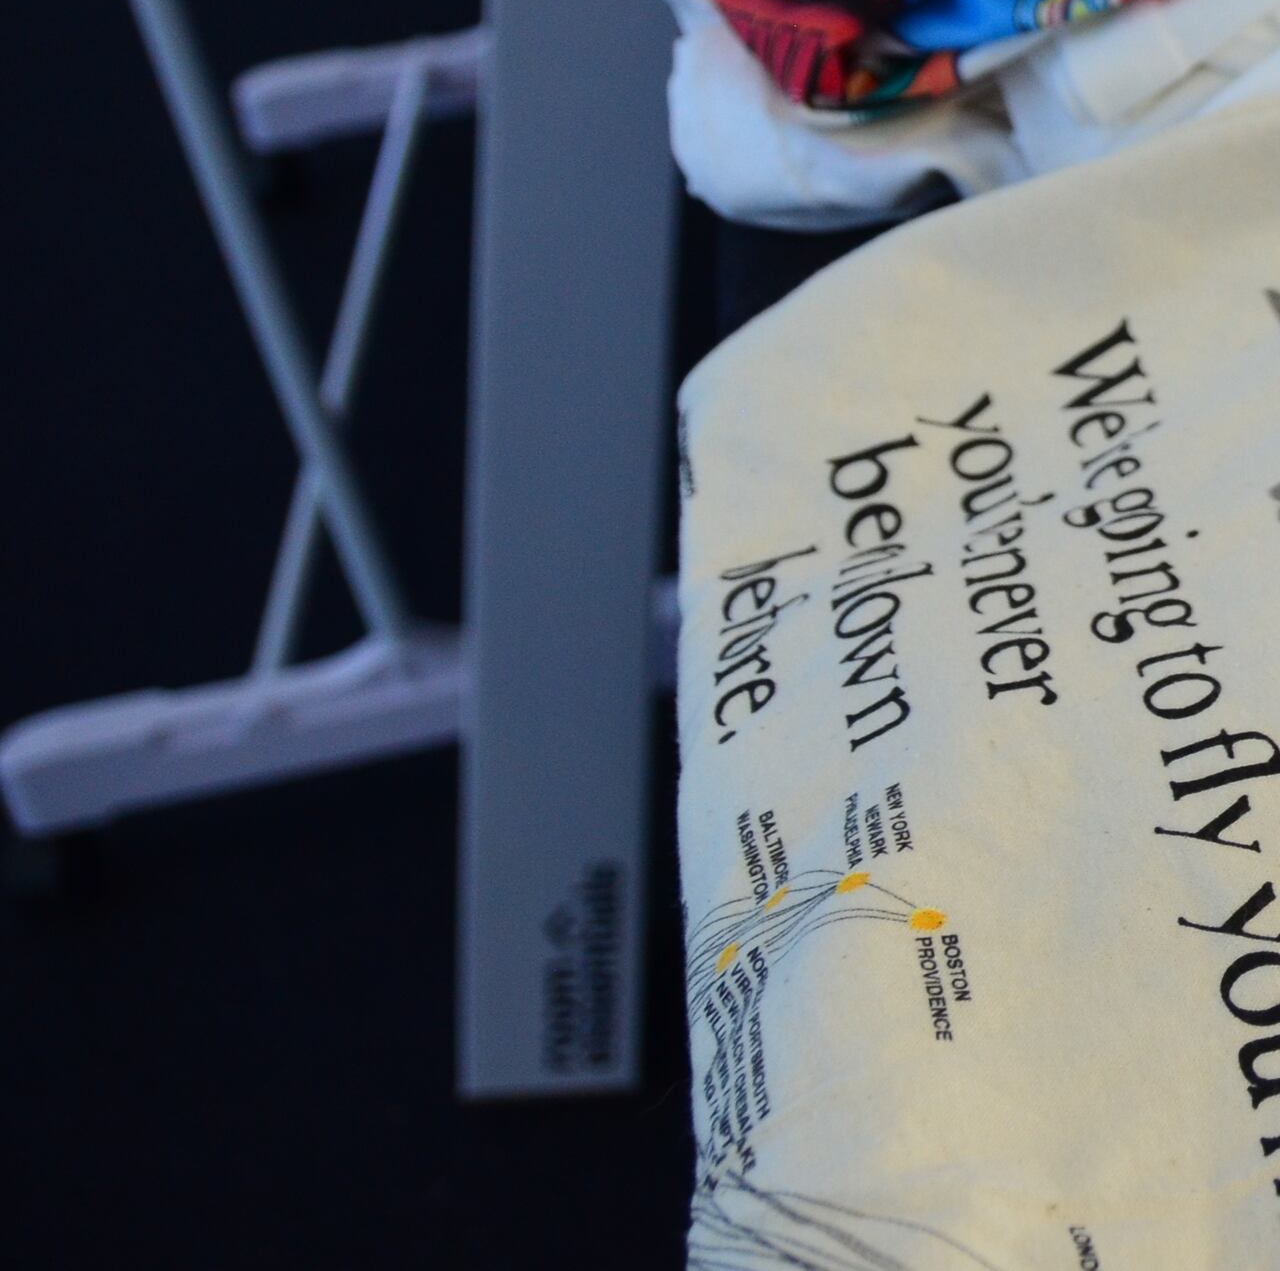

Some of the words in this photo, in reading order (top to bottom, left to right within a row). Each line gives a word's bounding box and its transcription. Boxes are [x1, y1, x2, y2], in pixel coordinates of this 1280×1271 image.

[1062, 485, 1199, 644] going
[1136, 641, 1226, 721] to
[843, 791, 864, 870] PHILDELPHIA
[885, 781, 904, 811] NEW
[890, 810, 915, 853] YORK
[736, 808, 770, 906] WASHINGTON
[914, 936, 953, 1042] PROVIDENCE
[941, 934, 972, 1003] BOSTON
